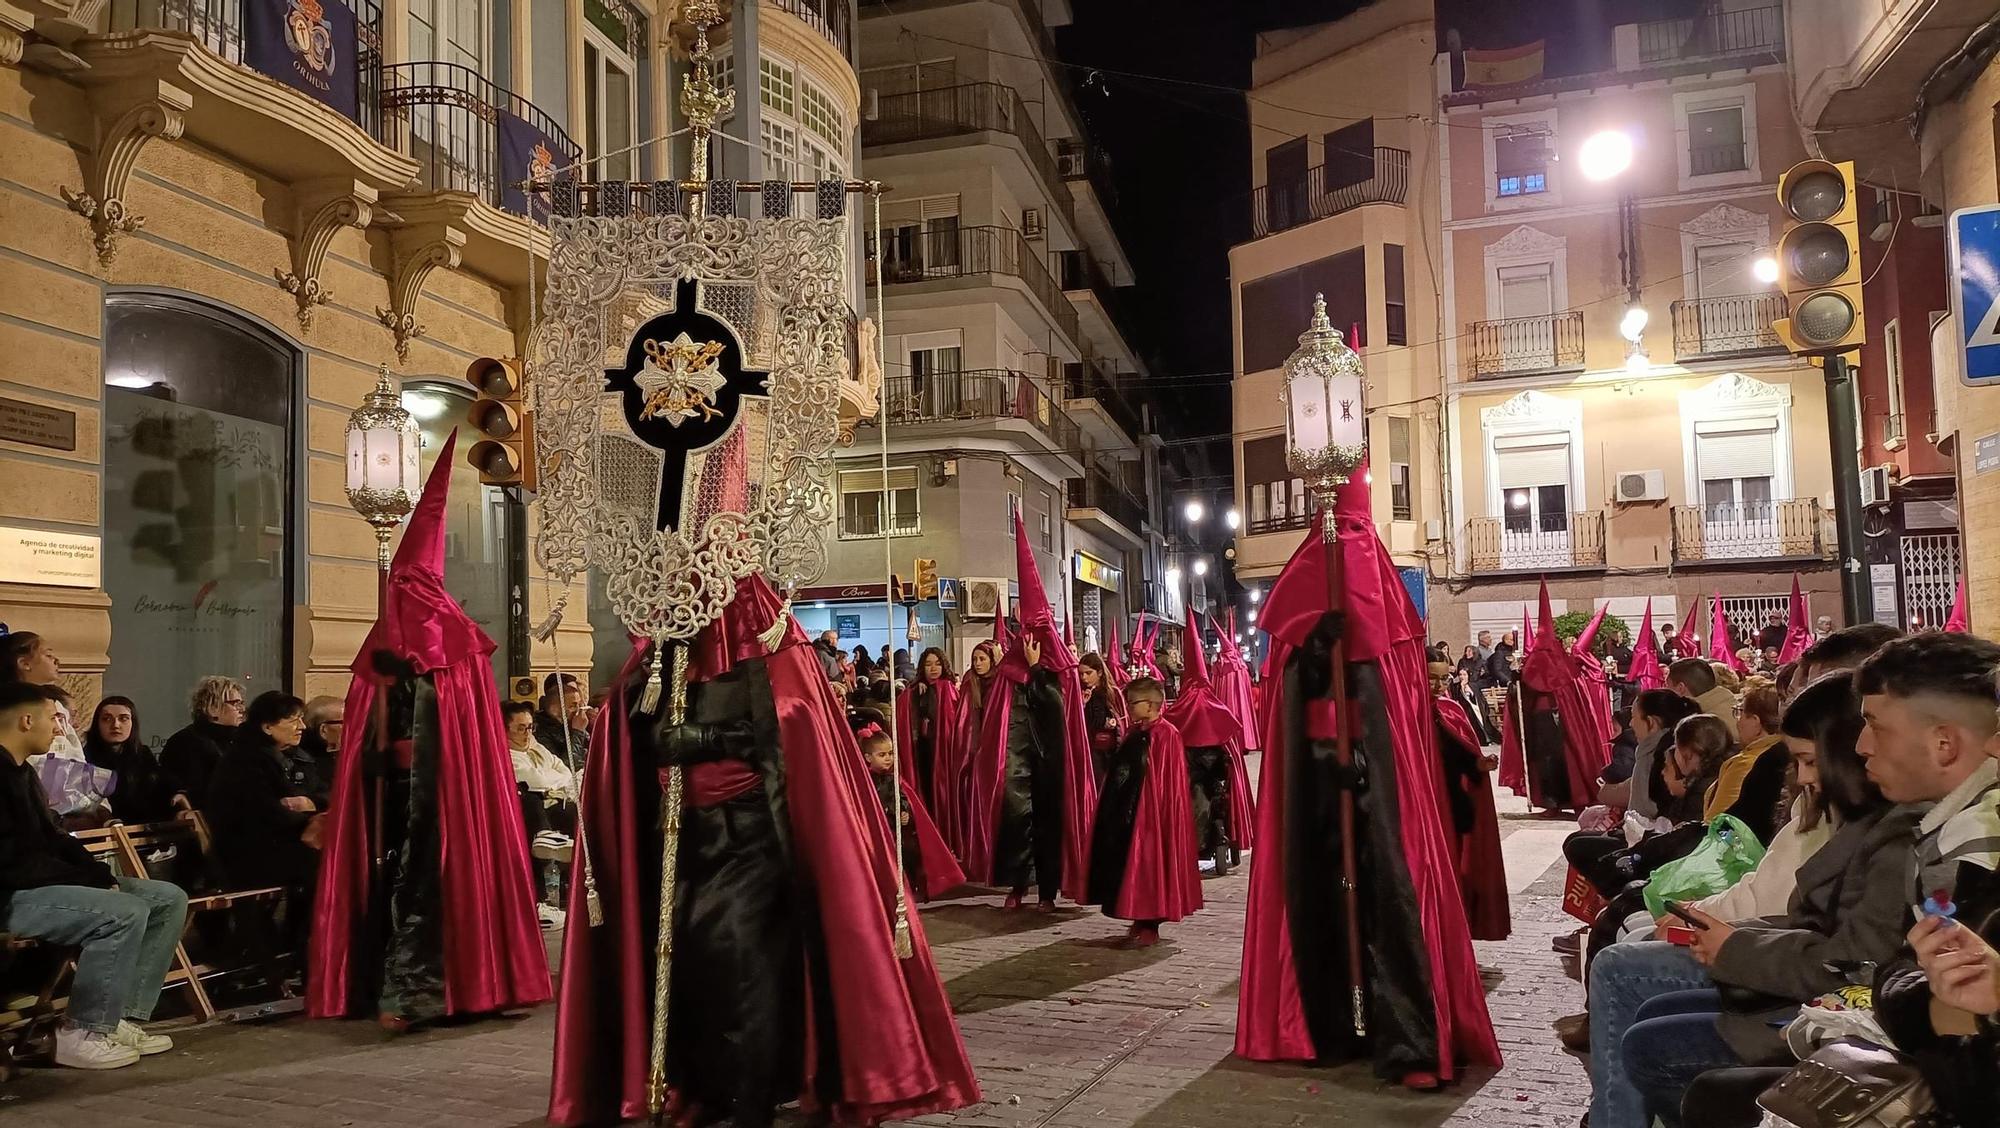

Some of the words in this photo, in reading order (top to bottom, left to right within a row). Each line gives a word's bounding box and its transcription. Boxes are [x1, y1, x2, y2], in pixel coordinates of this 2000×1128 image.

[20, 539, 48, 547] Agencia
[58, 543, 94, 552] creatividad
[38, 548, 73, 558] marketing
[74, 551, 94, 560] digital
[841, 587, 871, 597] Bar
